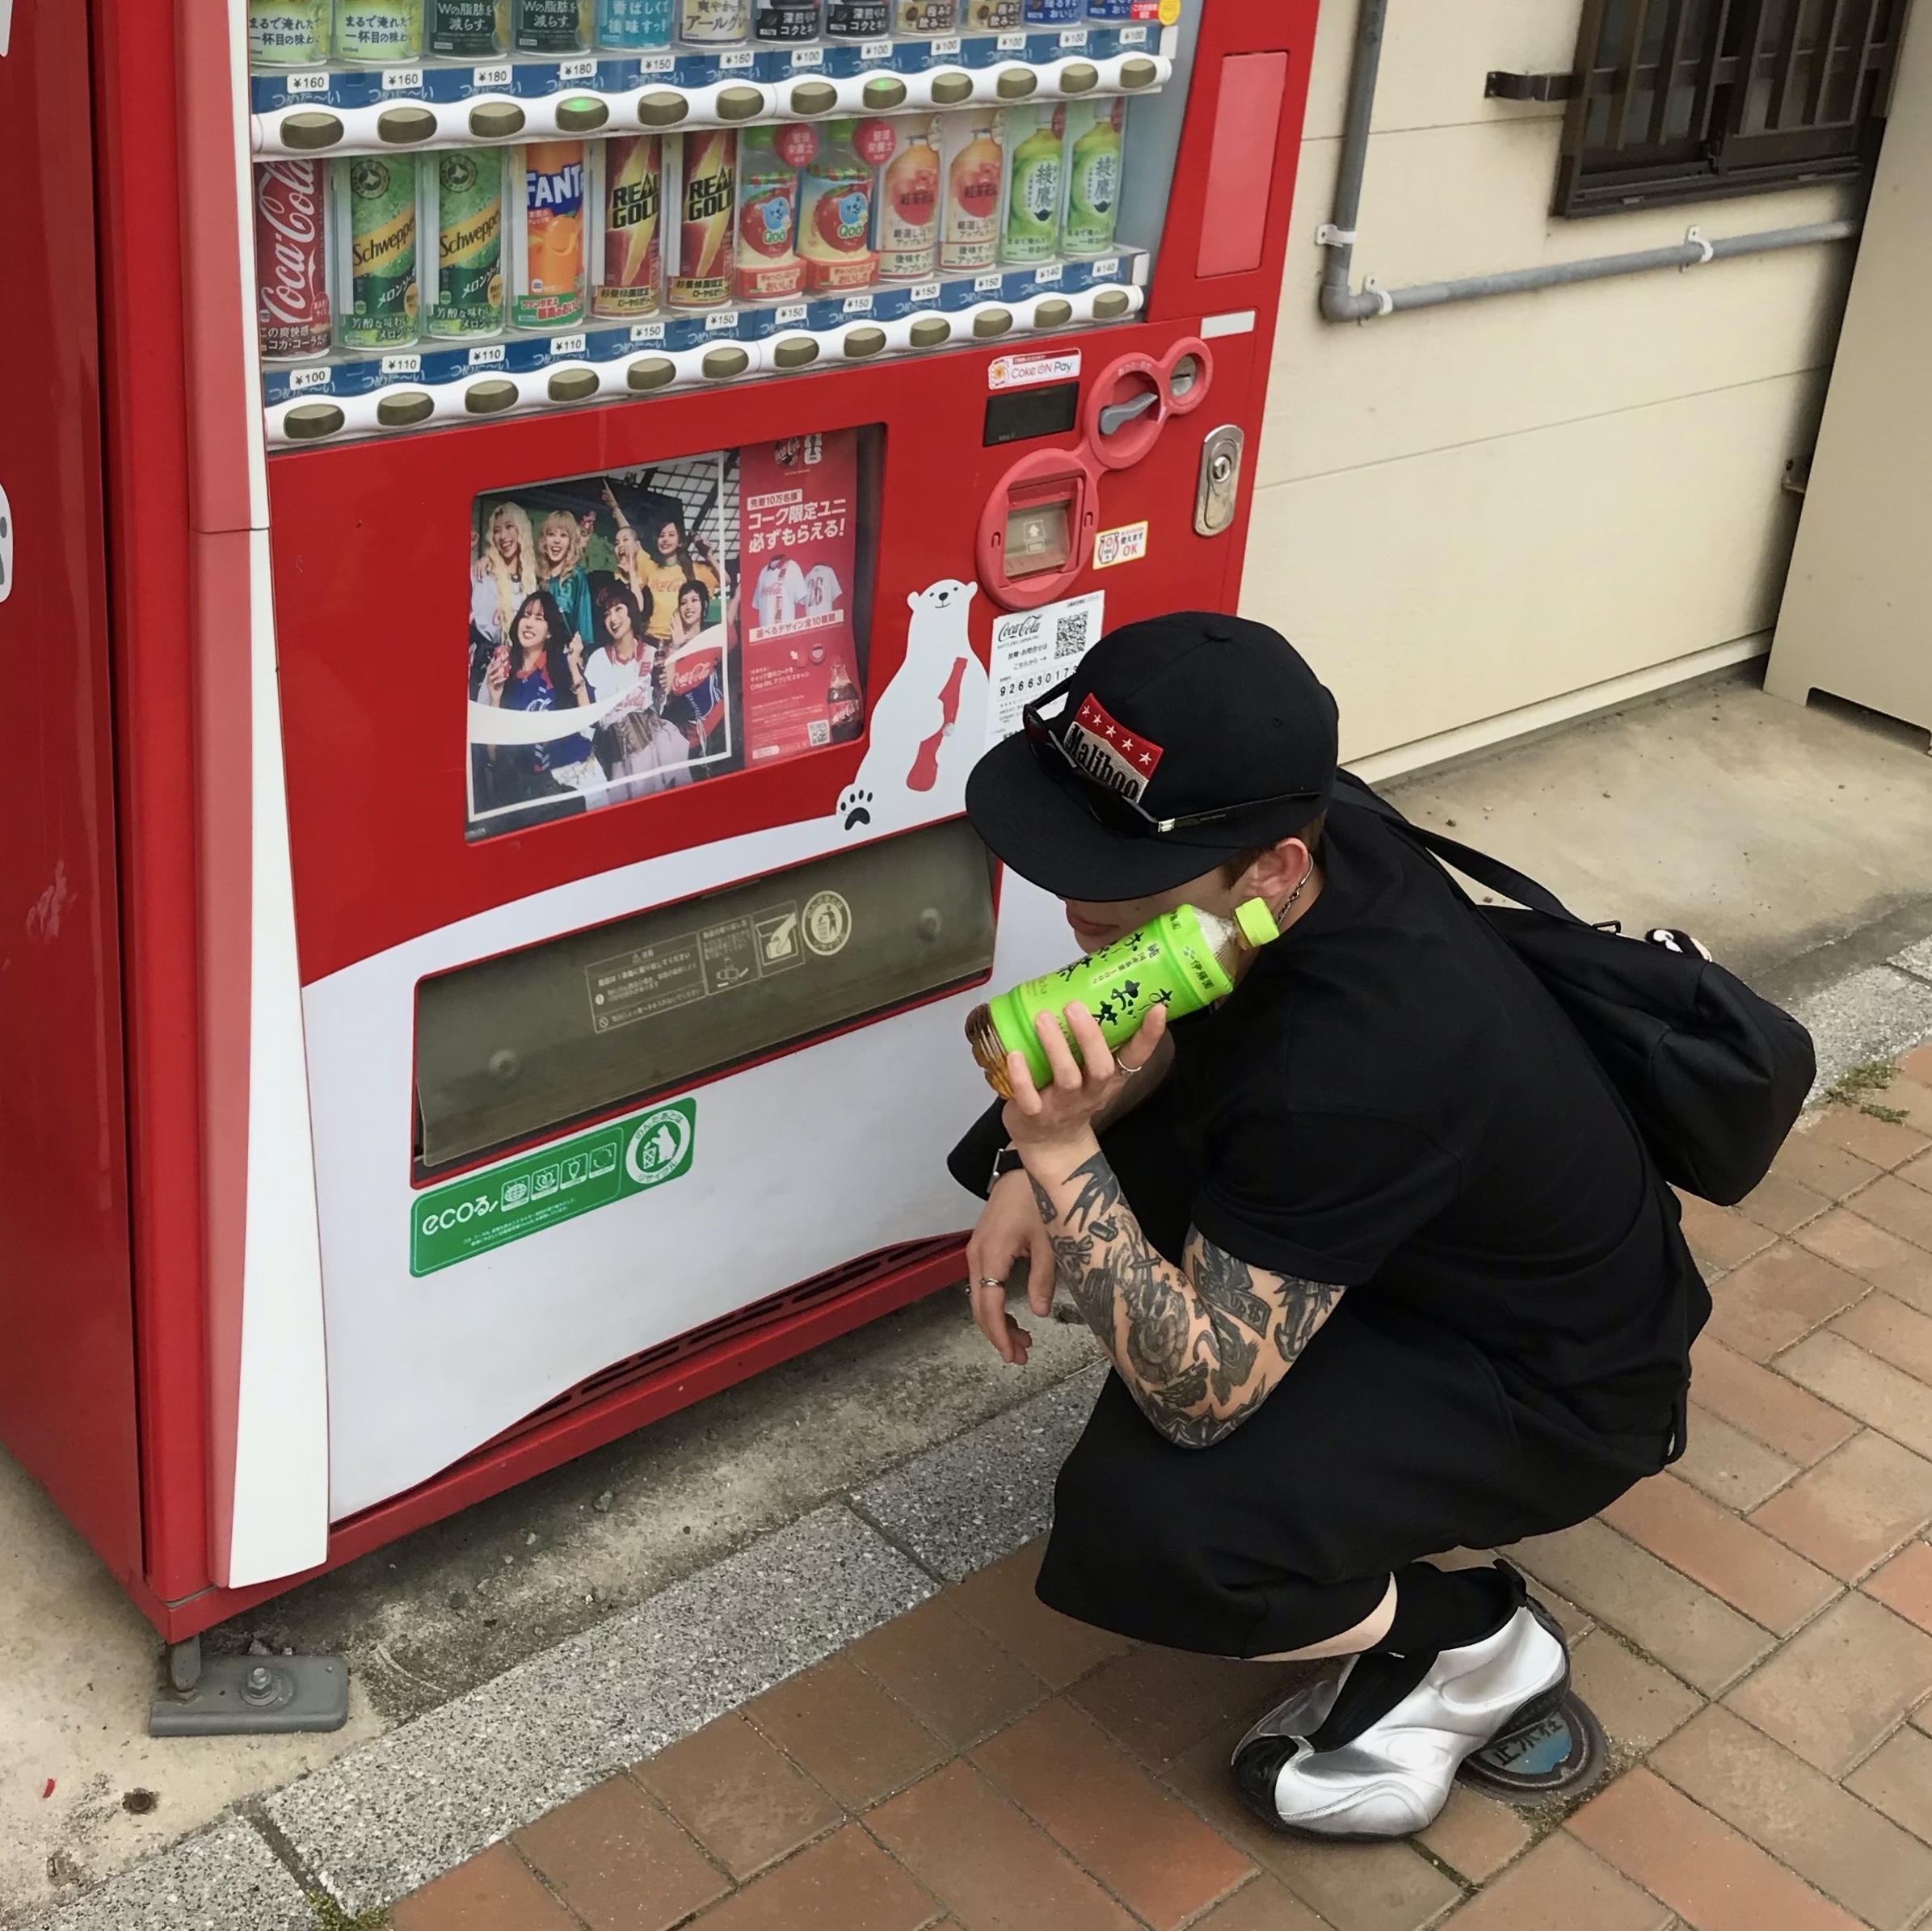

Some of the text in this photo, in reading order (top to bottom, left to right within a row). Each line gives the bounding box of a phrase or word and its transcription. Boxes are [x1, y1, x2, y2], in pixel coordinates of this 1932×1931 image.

[250, 33, 320, 45] 一杯目の味わ
[346, 32, 412, 44] 一杯目の味わ
[797, 51, 819, 61] ¥100
[866, 45, 889, 55] ¥100
[565, 64, 591, 75] ¥180
[646, 58, 671, 69] ¥150
[389, 74, 419, 85] ¥160
[479, 71, 507, 82] ¥180
[293, 78, 325, 88] ¥160
[764, 230, 786, 242] Qoo
[840, 225, 862, 238] Qoo
[915, 286, 937, 297] ¥150
[847, 299, 869, 309] ¥150
[781, 307, 804, 318] ¥150
[711, 314, 734, 326] ¥150
[636, 326, 661, 337] ¥150
[555, 339, 582, 351] ¥110
[474, 348, 501, 361] ¥110
[388, 359, 417, 370] ¥110
[1012, 368, 1036, 378] Coke
[1054, 361, 1073, 373] Pay
[295, 371, 326, 385] ¥100
[748, 499, 846, 530] コーク限定ユニ
[749, 518, 846, 553] 必ずもらえる!
[1123, 544, 1138, 556] OK
[1190, 960, 1214, 990] 伊藤園
